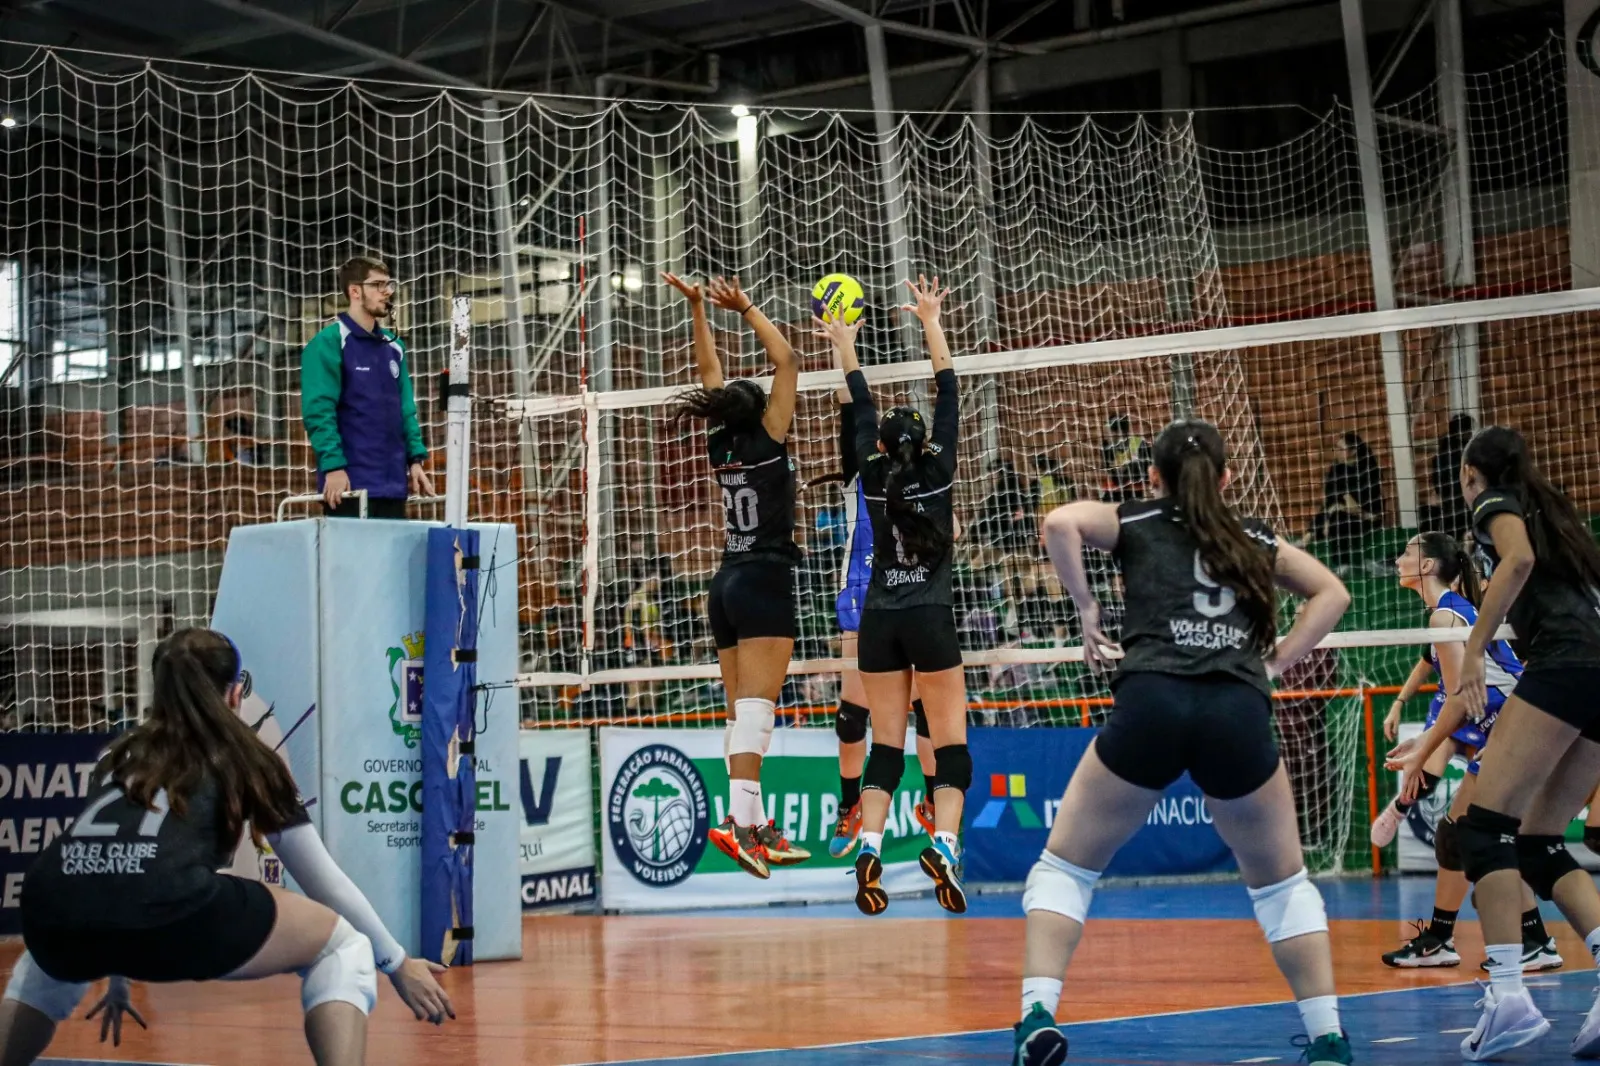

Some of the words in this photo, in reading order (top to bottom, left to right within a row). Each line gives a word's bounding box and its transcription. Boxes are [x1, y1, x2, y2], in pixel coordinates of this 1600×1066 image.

[886, 571, 926, 586] CAAVEL
[363, 759, 422, 773] GOVERNO
[611, 751, 652, 823] FEDERAÇÃO
[654, 750, 707, 820] PARANAENSE
[340, 780, 511, 815] CASCEL
[367, 819, 419, 833] Secretaria
[107, 842, 159, 859] CLUBE
[62, 858, 146, 875] CASCAVEL
[634, 860, 689, 882] VOLEIBOL
[521, 873, 594, 904] CANAL
